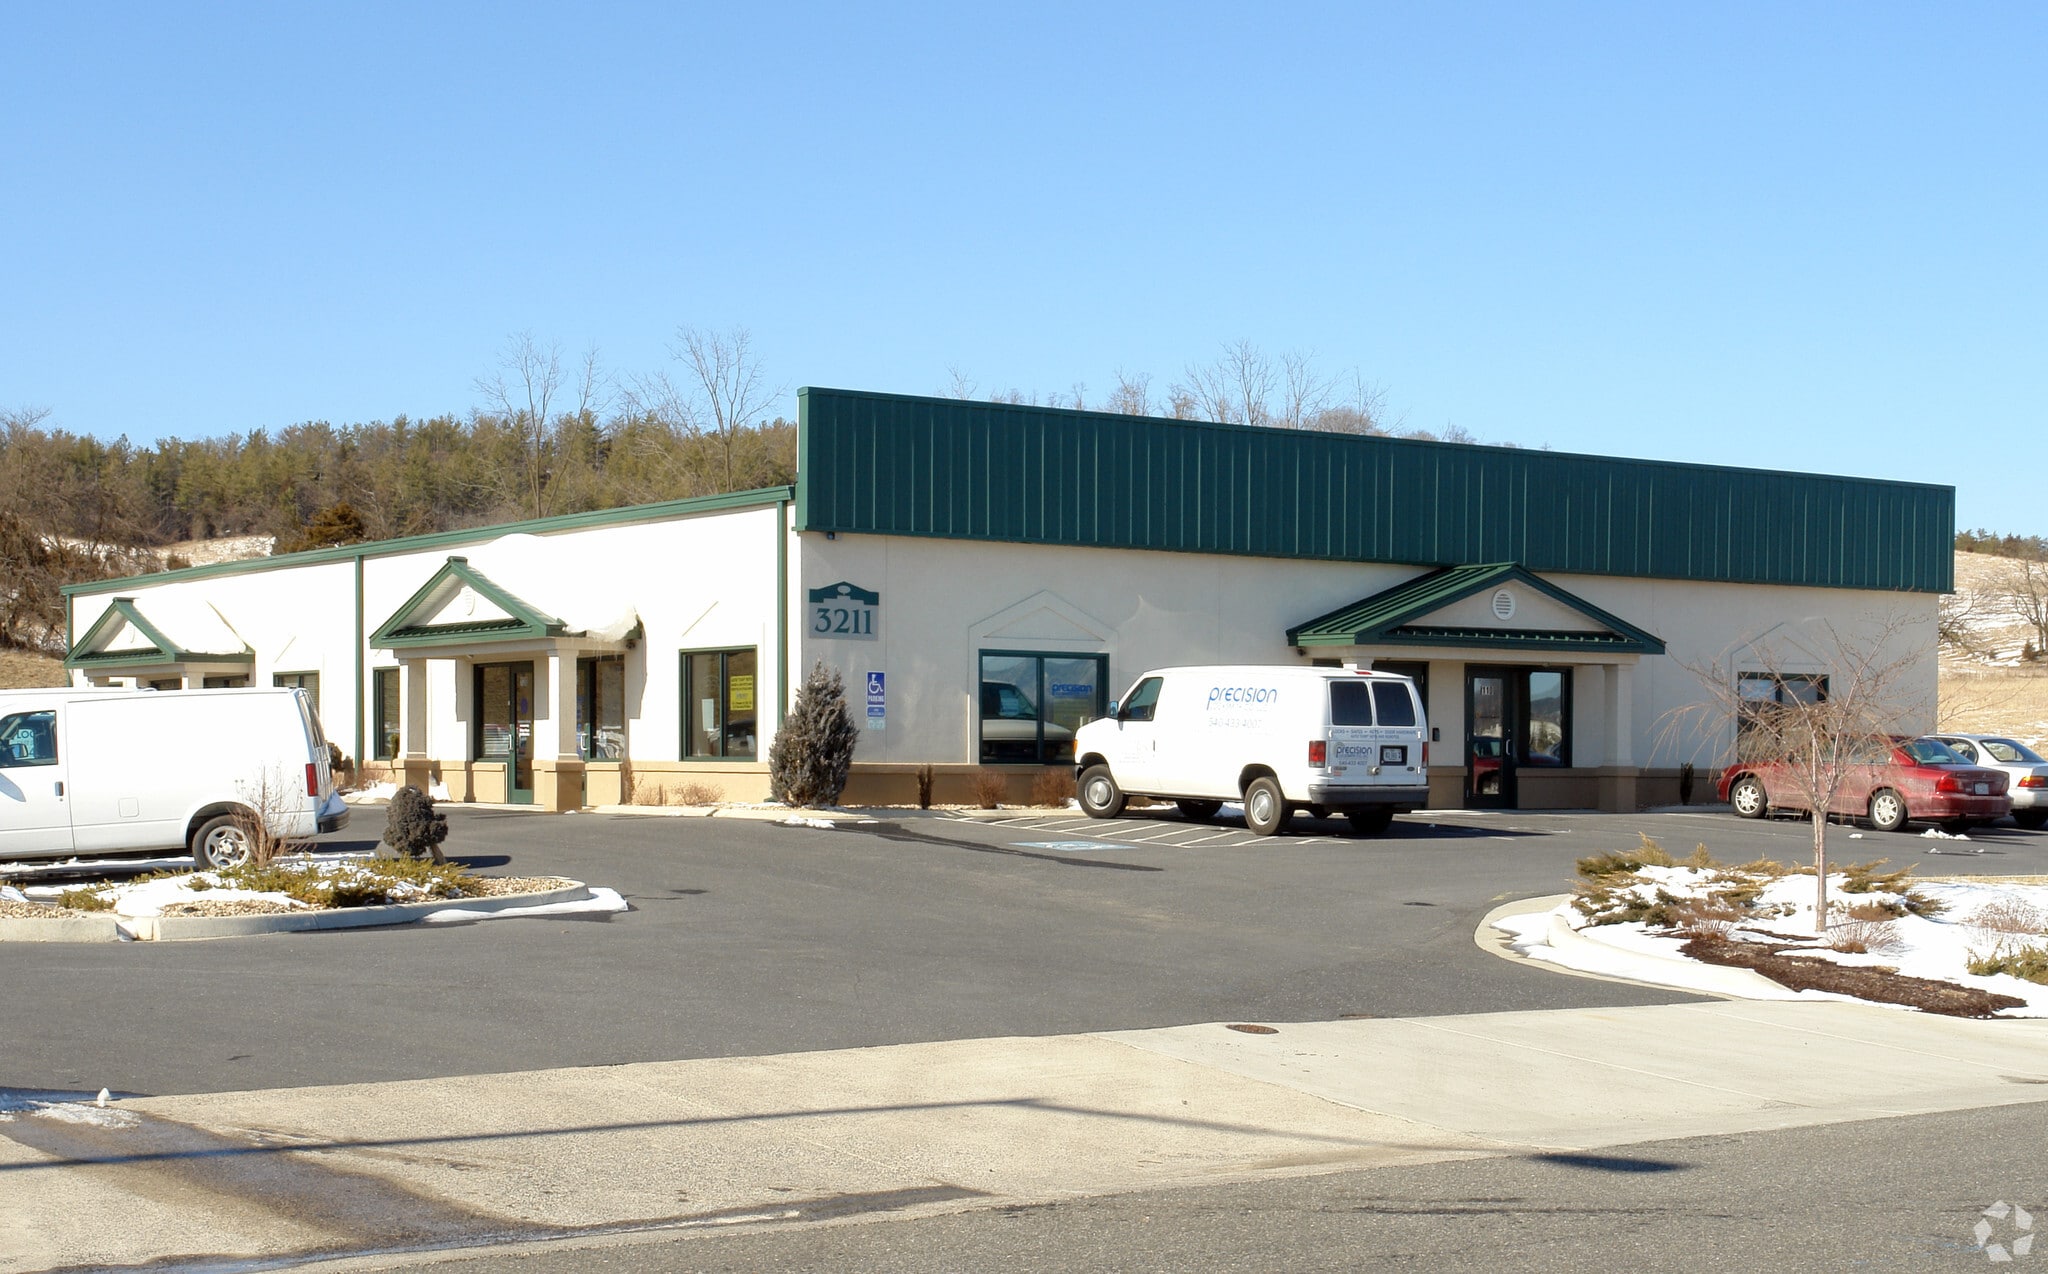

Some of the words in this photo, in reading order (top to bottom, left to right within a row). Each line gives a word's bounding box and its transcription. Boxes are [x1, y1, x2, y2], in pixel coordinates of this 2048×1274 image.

[814, 608, 872, 634] 3211
[1206, 686, 1278, 711] precision
[1335, 746, 1372, 758] precision
